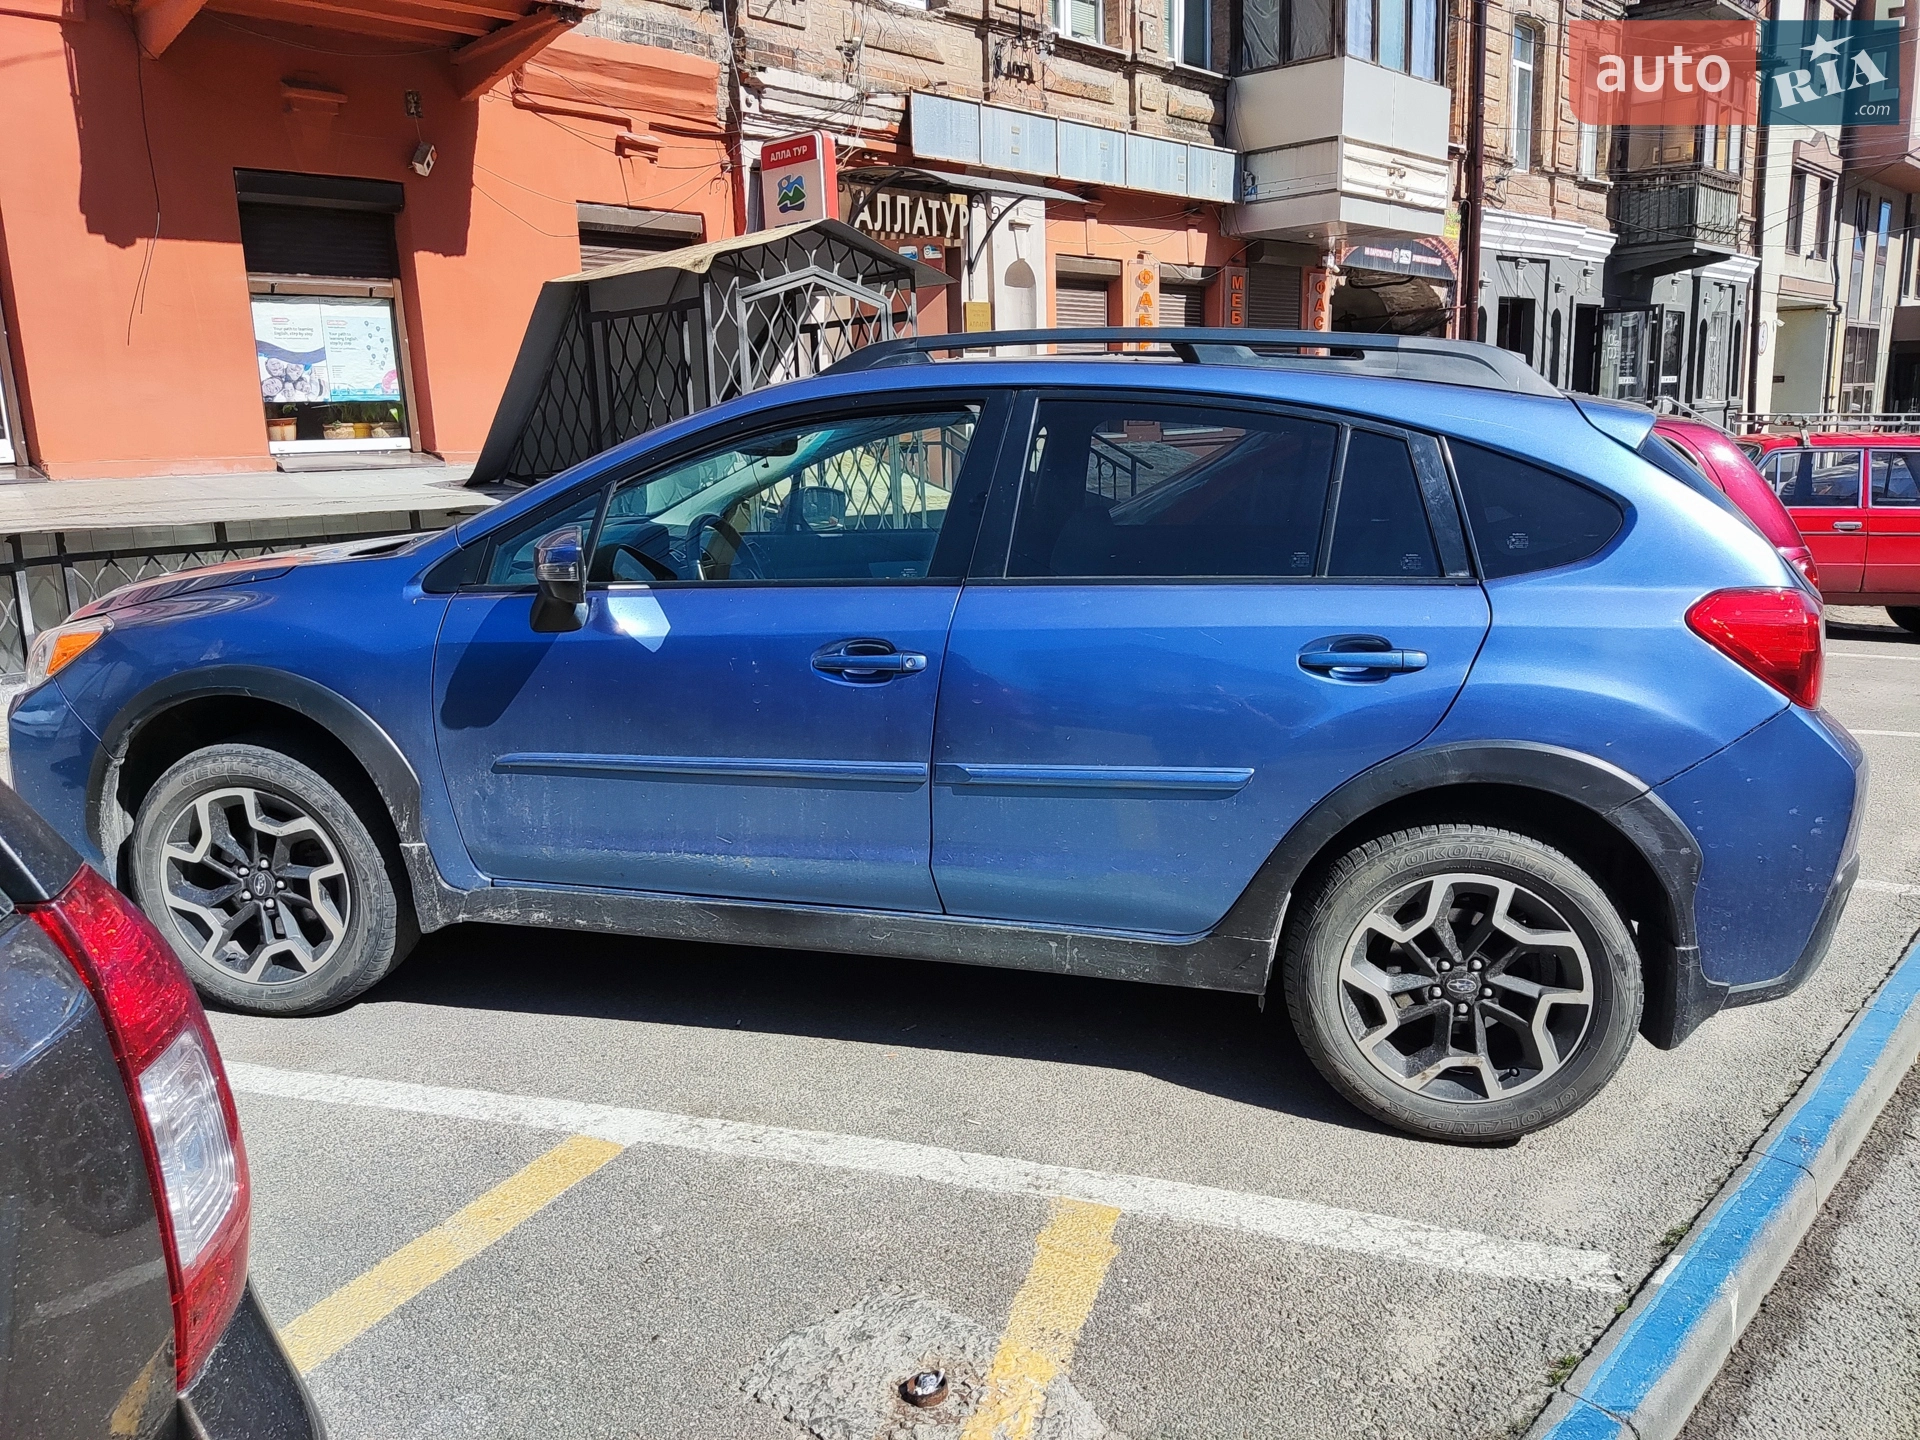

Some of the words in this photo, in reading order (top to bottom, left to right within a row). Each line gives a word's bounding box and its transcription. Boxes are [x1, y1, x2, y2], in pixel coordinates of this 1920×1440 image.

[770, 149, 792, 162] АЛЛА
[793, 145, 808, 157] ТУР
[854, 191, 970, 239] АЛЛАТУР
[1231, 275, 1244, 325] МЕБ
[1384, 844, 1558, 881] YOKOHAMA
